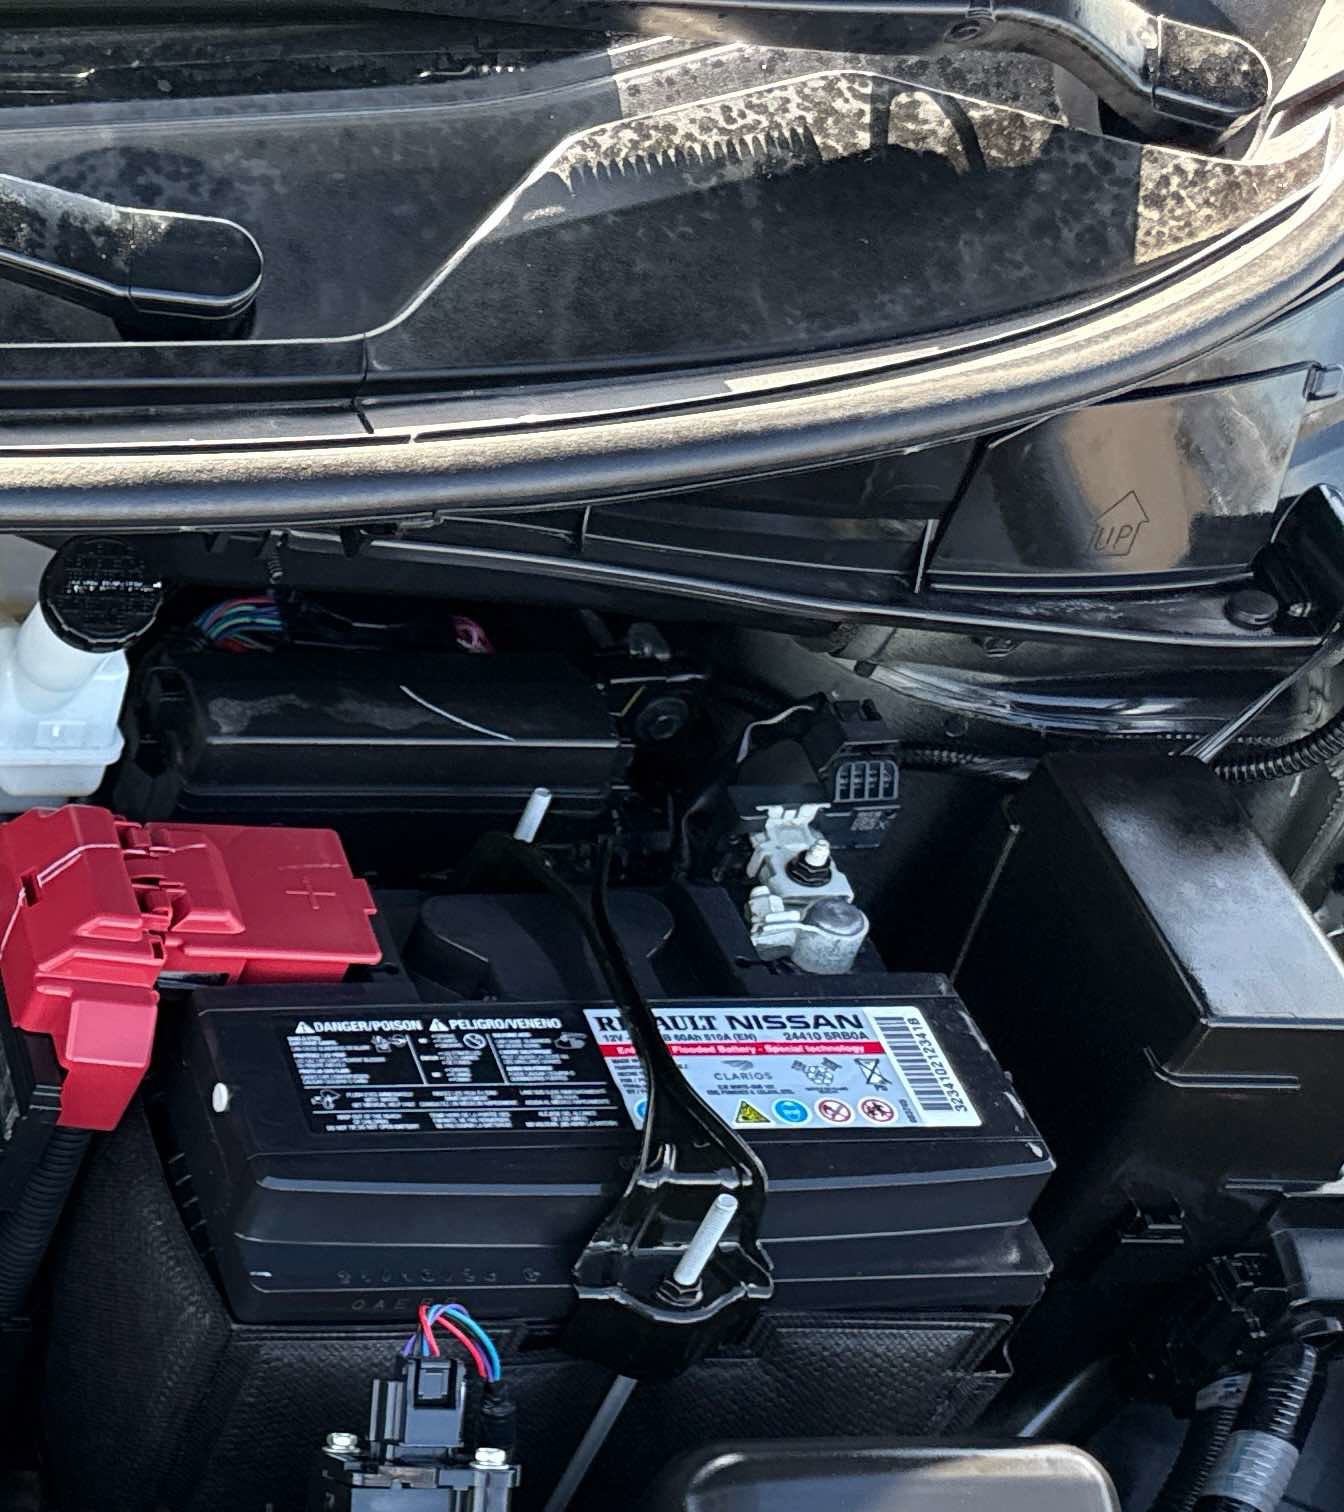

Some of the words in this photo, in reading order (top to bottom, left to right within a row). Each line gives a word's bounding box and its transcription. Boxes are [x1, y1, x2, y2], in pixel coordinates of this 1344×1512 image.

[1094, 523, 1135, 552] UP
[312, 1020, 423, 1033] DANGER/POISON
[448, 1018, 562, 1030] PELIGRO/VENENO
[592, 1015, 718, 1031] RAULT
[724, 1014, 864, 1030] NISSAN
[783, 1031, 822, 1040] 24410
[713, 1071, 773, 1081] CLARIOS
